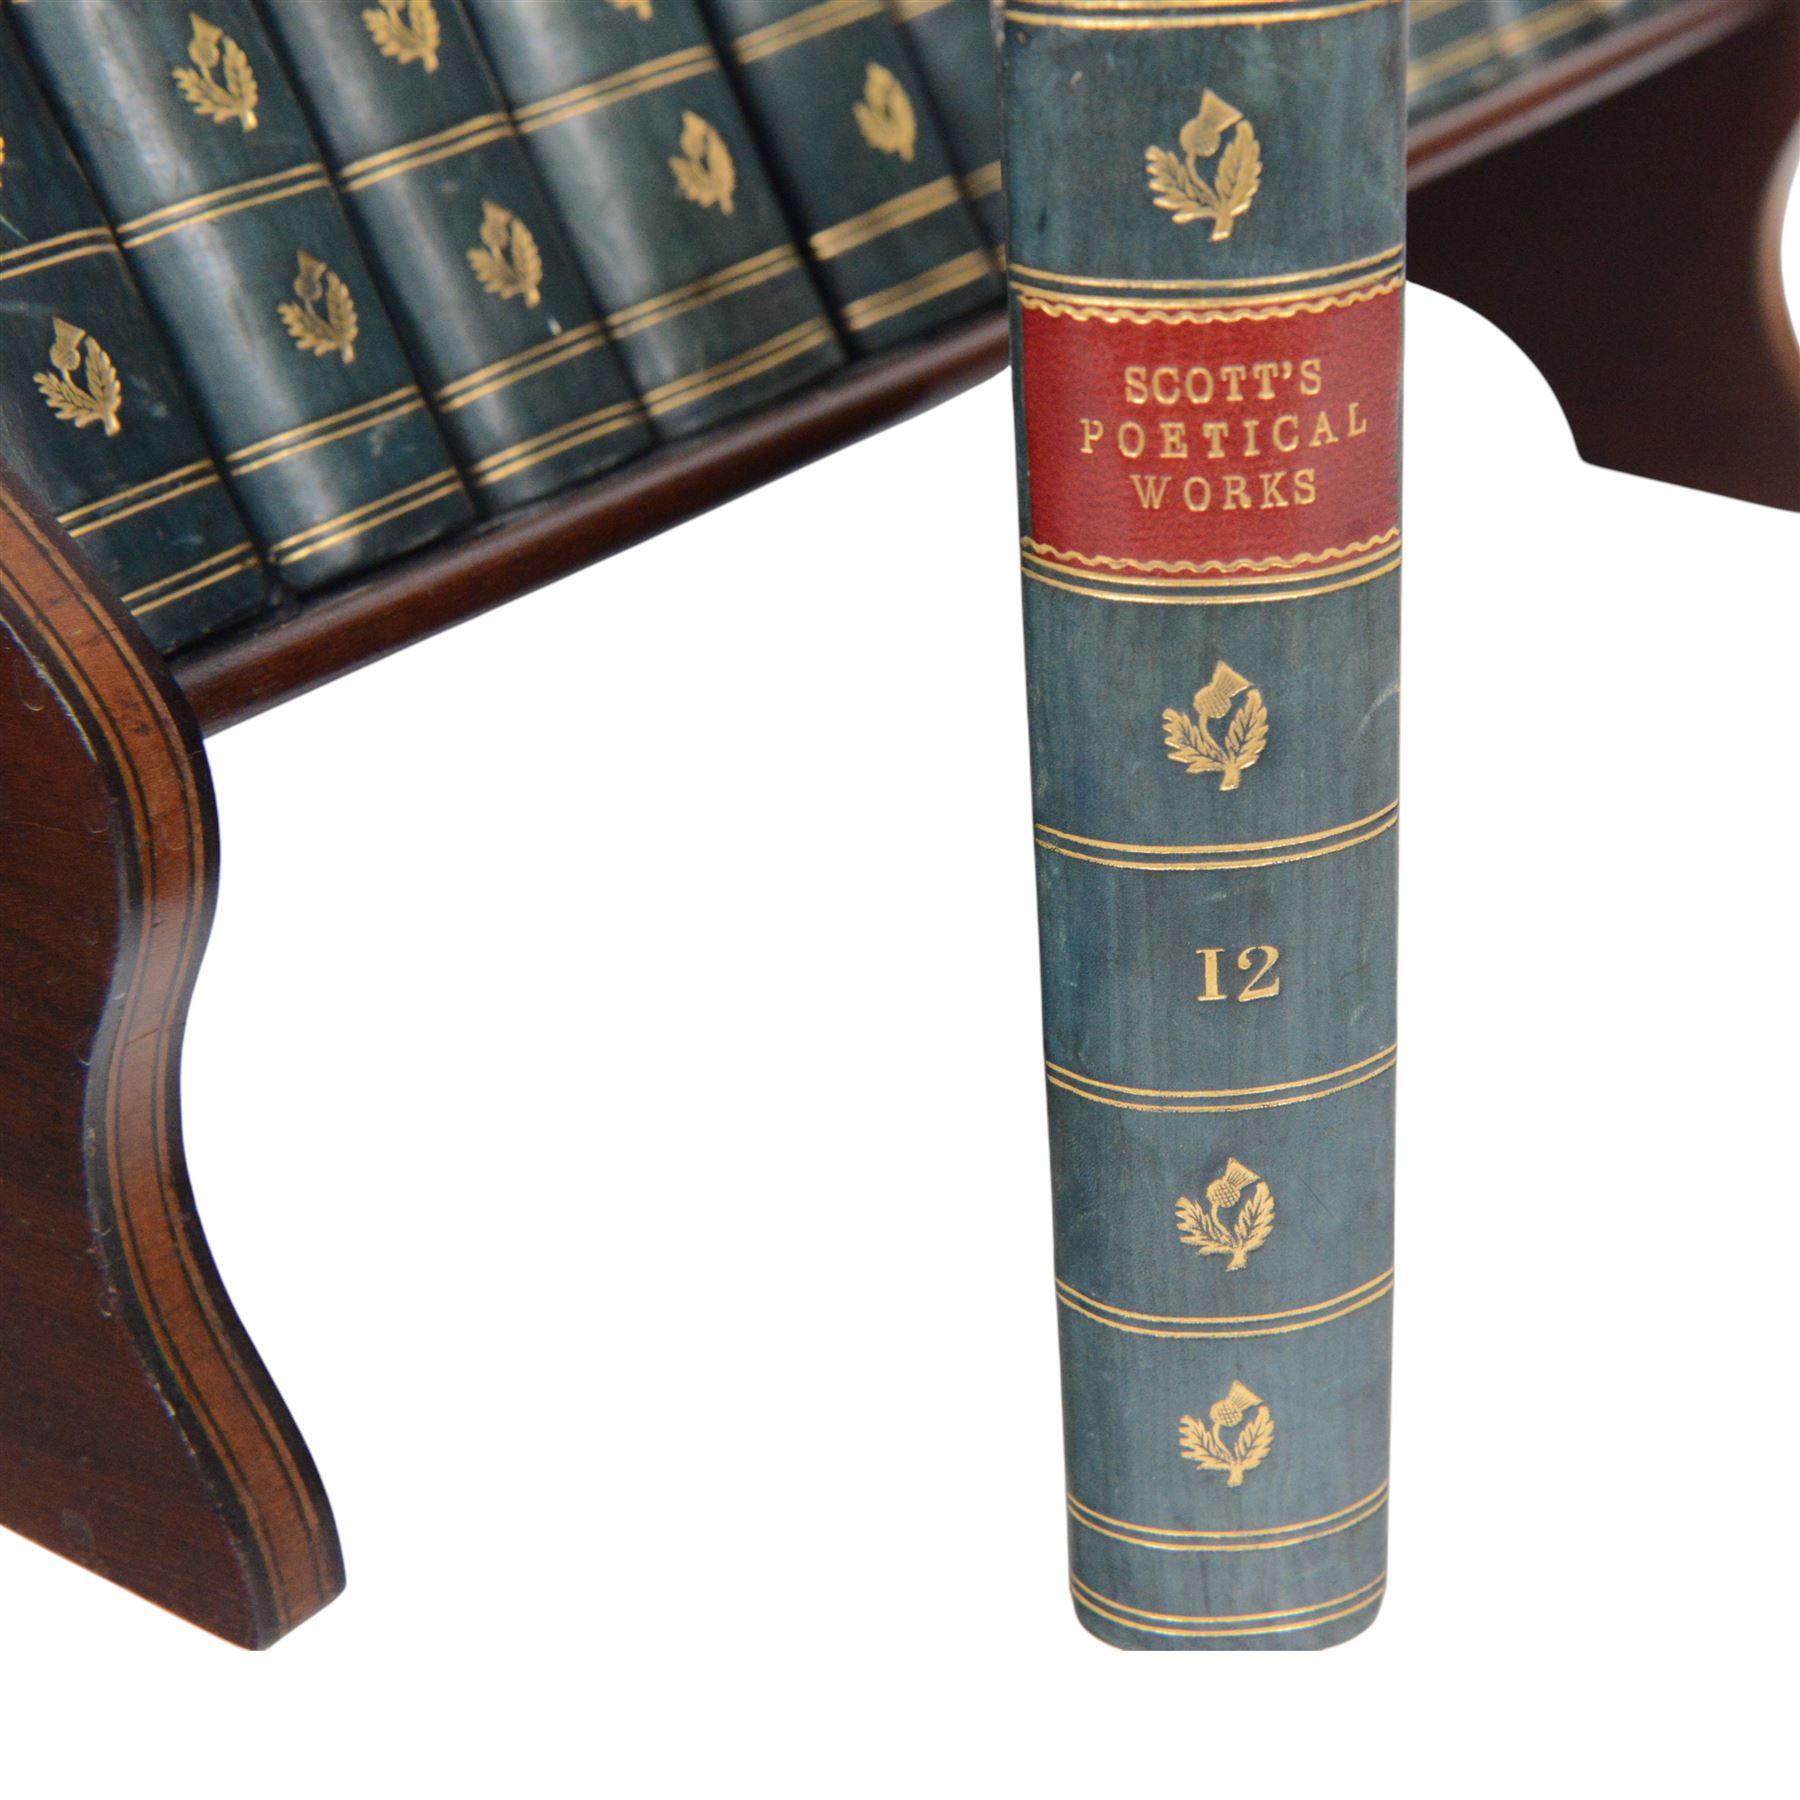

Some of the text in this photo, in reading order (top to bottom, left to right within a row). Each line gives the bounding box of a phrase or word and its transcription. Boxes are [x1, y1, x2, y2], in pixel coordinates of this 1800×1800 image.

[1124, 358, 1322, 405] SCOTT'S
[1080, 402, 1368, 459] POETICAL
[1129, 468, 1317, 512] WORKS
[1195, 945, 1281, 1002] 12
